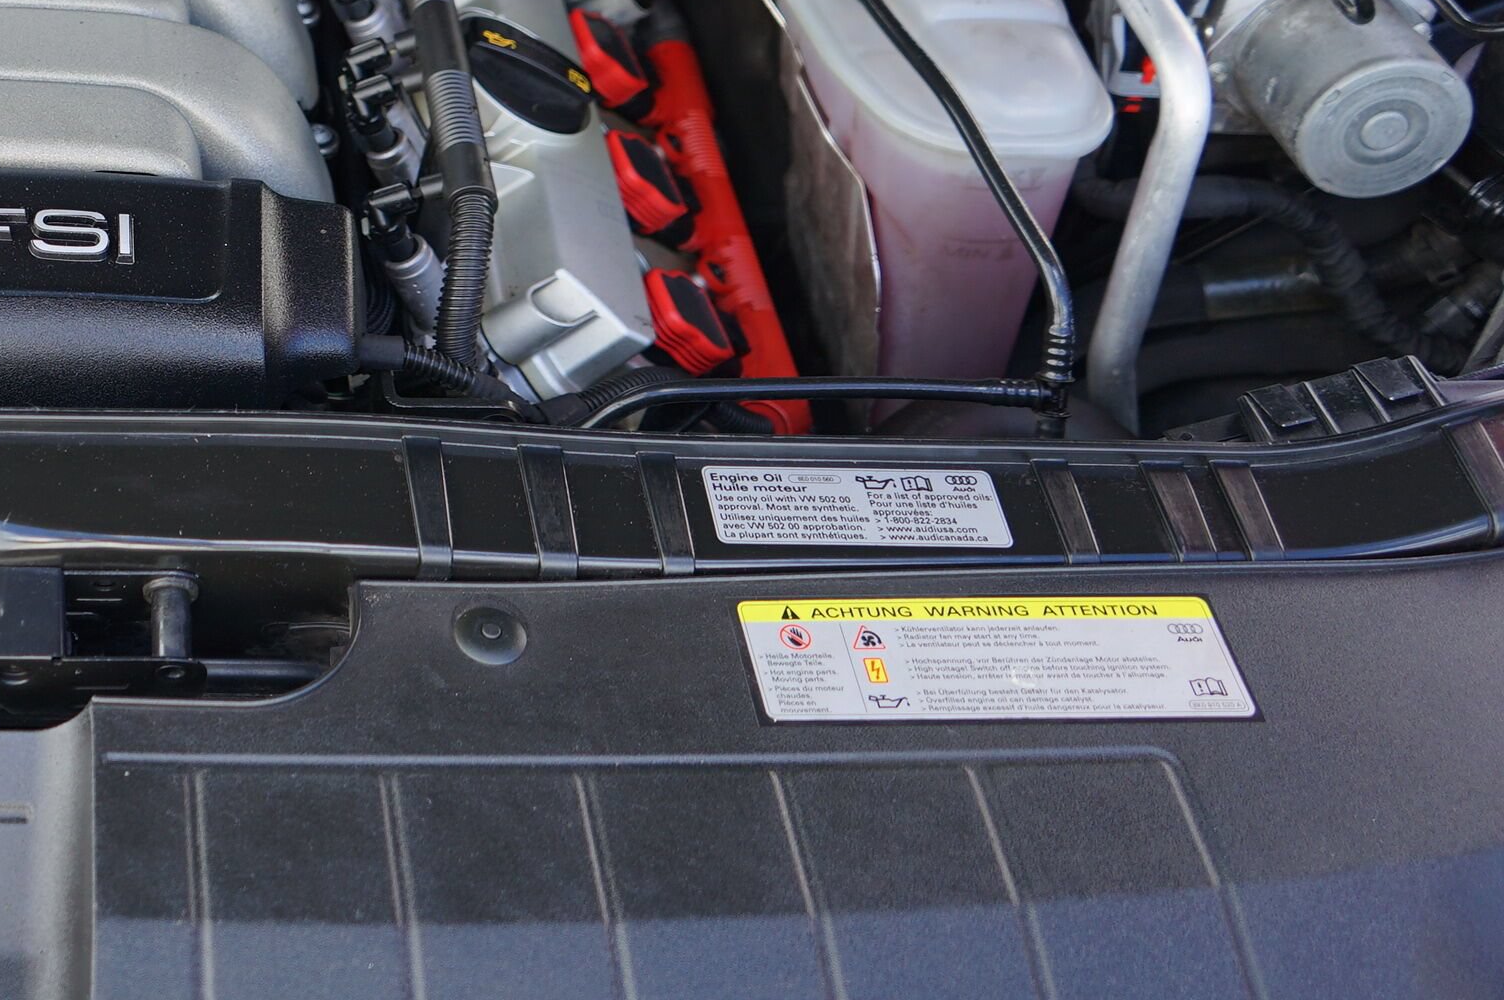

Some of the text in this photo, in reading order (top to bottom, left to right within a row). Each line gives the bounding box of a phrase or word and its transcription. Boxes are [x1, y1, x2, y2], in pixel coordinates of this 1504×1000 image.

[710, 472, 783, 484] Engine Oil
[712, 483, 807, 493] Huile moteur
[737, 494, 757, 504] only
[761, 494, 773, 502] oil
[799, 495, 816, 503] VW
[867, 491, 883, 500] For
[895, 492, 909, 500] list
[911, 492, 921, 500] of
[924, 494, 970, 502] approved
[973, 494, 993, 502] oils:
[718, 503, 763, 512] approval.
[766, 503, 791, 511] Most
[812, 504, 859, 513] synthetic.
[870, 500, 894, 508] Pour
[916, 501, 937, 509] liste
[939, 501, 978, 509] d'huiles
[720, 513, 870, 523] Utilisez uniquement des huiles
[873, 508, 933, 518] approuvées:
[884, 517, 958, 525] 1-800-822-2834
[803, 523, 866, 532] approbation.
[886, 526, 978, 534] www.audiusa.com
[739, 531, 774, 540] plupart
[801, 532, 867, 541] synthétiques.
[889, 534, 989, 542] www.audicanada.ca
[810, 604, 1159, 619] ACHTUNG WARNING ATTENTION
